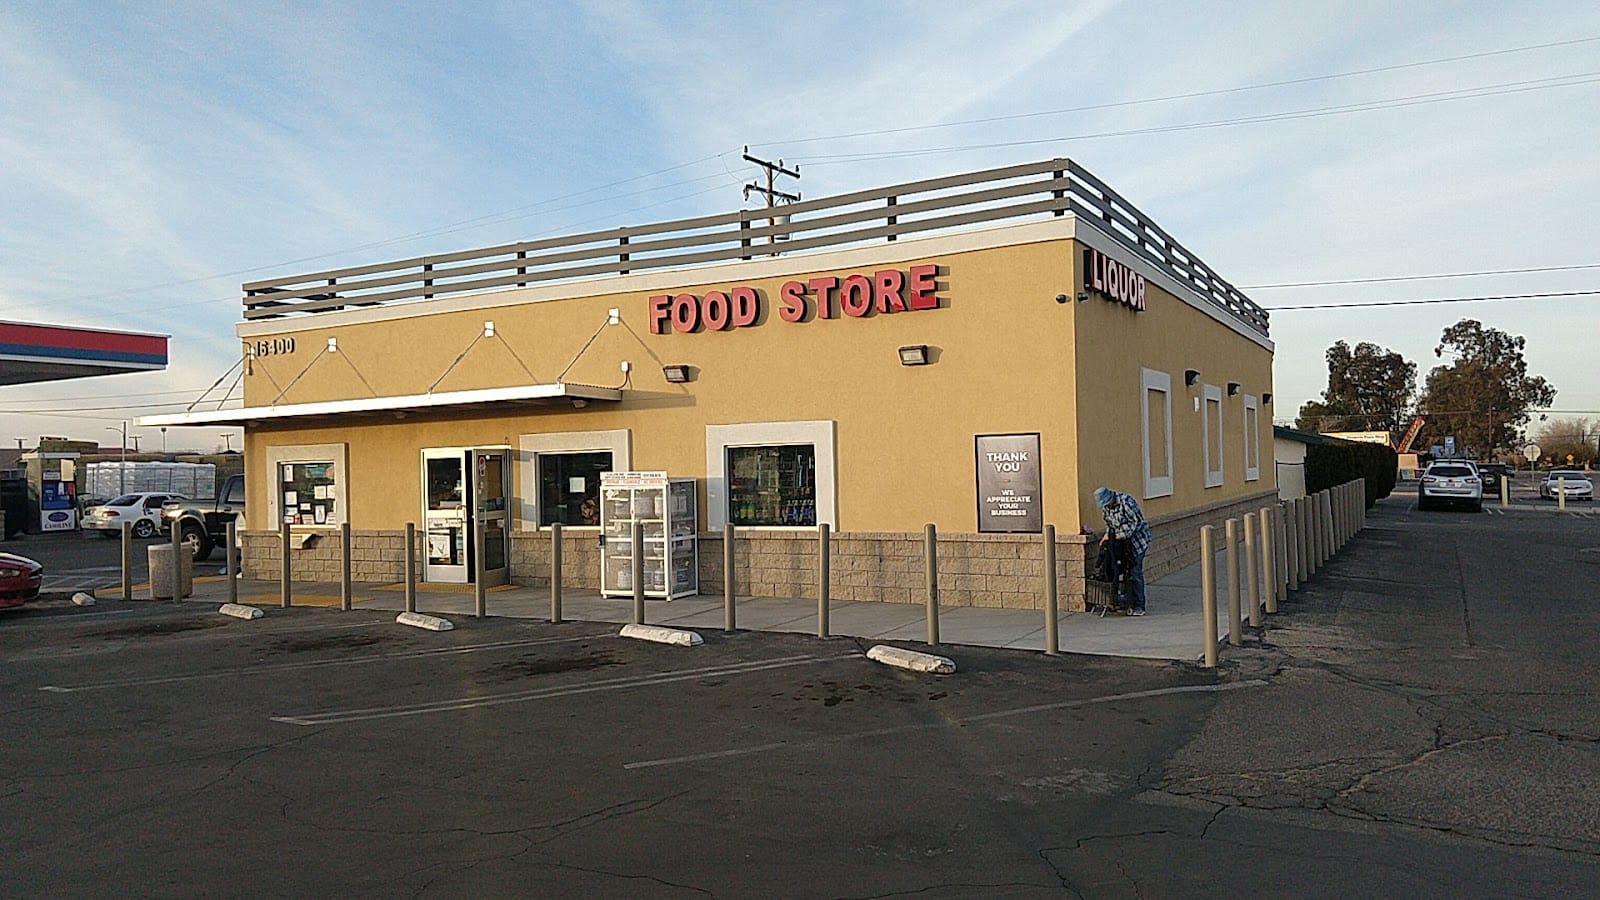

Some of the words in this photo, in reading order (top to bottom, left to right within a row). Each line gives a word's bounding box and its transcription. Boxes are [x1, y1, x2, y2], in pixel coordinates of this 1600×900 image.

[1089, 248, 1146, 311] LIQUOR
[649, 286, 759, 334] FOOD
[779, 264, 937, 322] STORE
[256, 338, 295, 357] 16400
[986, 451, 1028, 462] THANK
[995, 462, 1020, 472] YOU
[986, 495, 1031, 503] APPRECIATE
